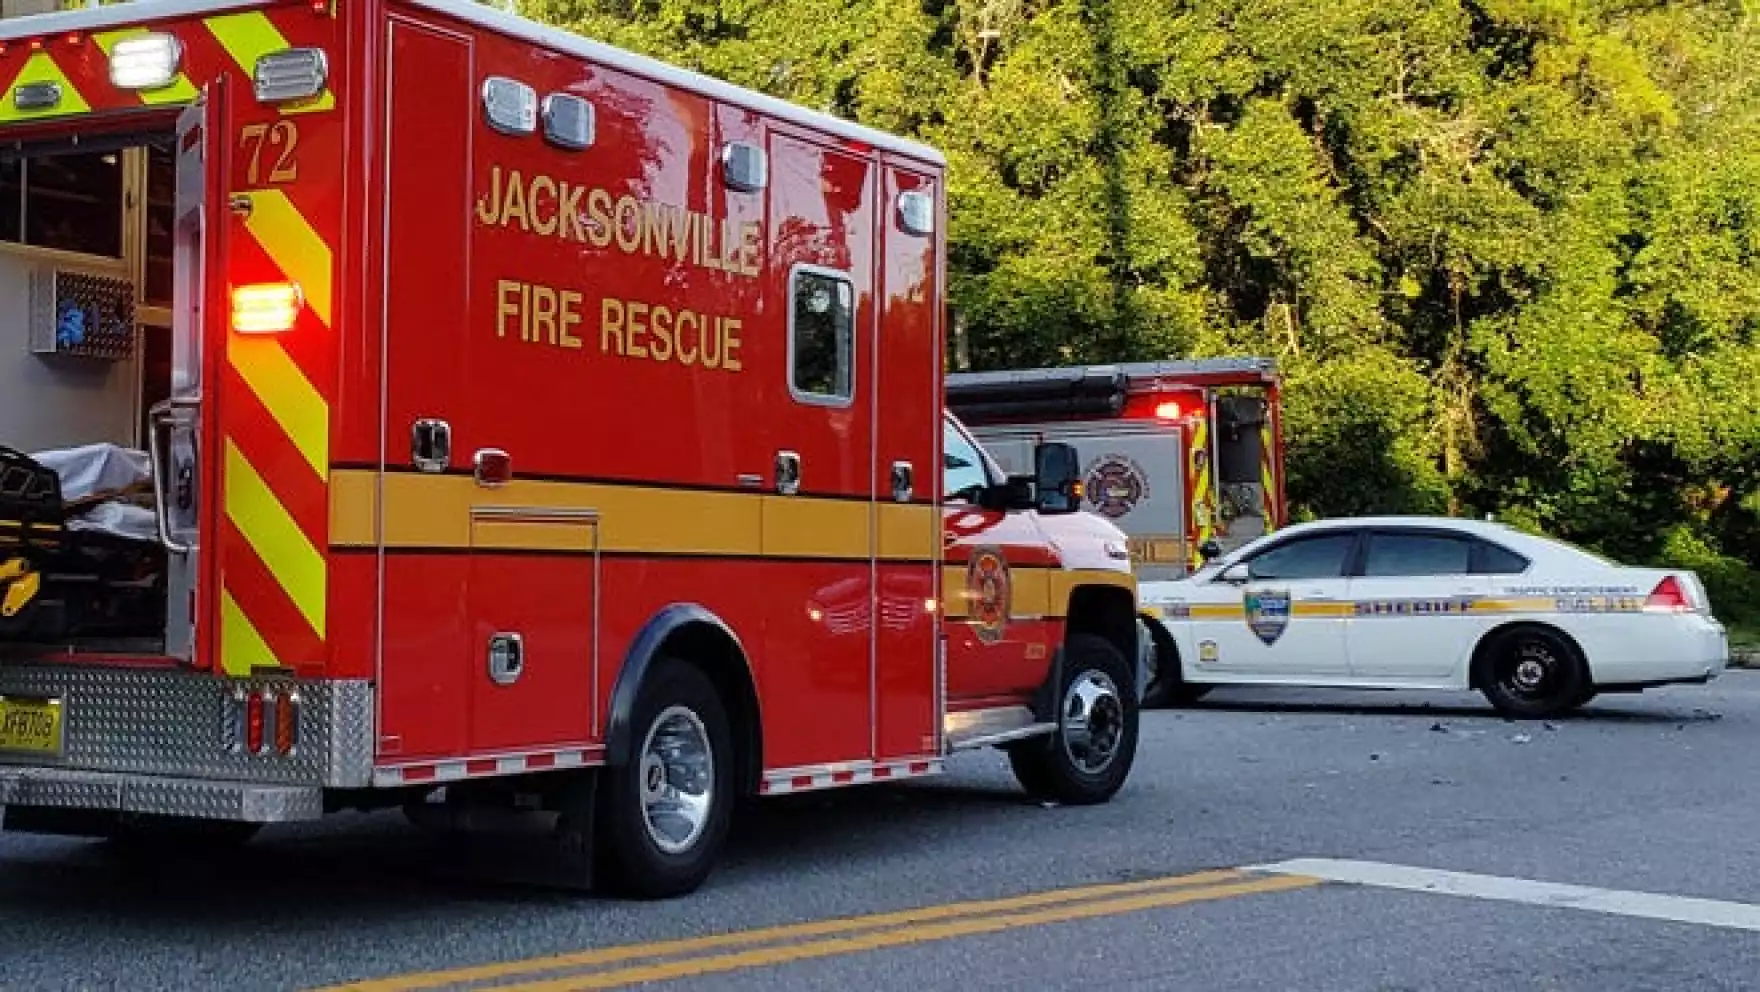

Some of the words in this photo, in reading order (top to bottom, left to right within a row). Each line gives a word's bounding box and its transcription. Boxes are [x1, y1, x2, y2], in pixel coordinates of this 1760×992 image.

[240, 119, 297, 185] 72
[476, 166, 760, 278] JACKSONVILLE
[497, 279, 582, 348] FIRE
[601, 297, 742, 371] RESCUE
[1354, 598, 1473, 615] SHERIFF
